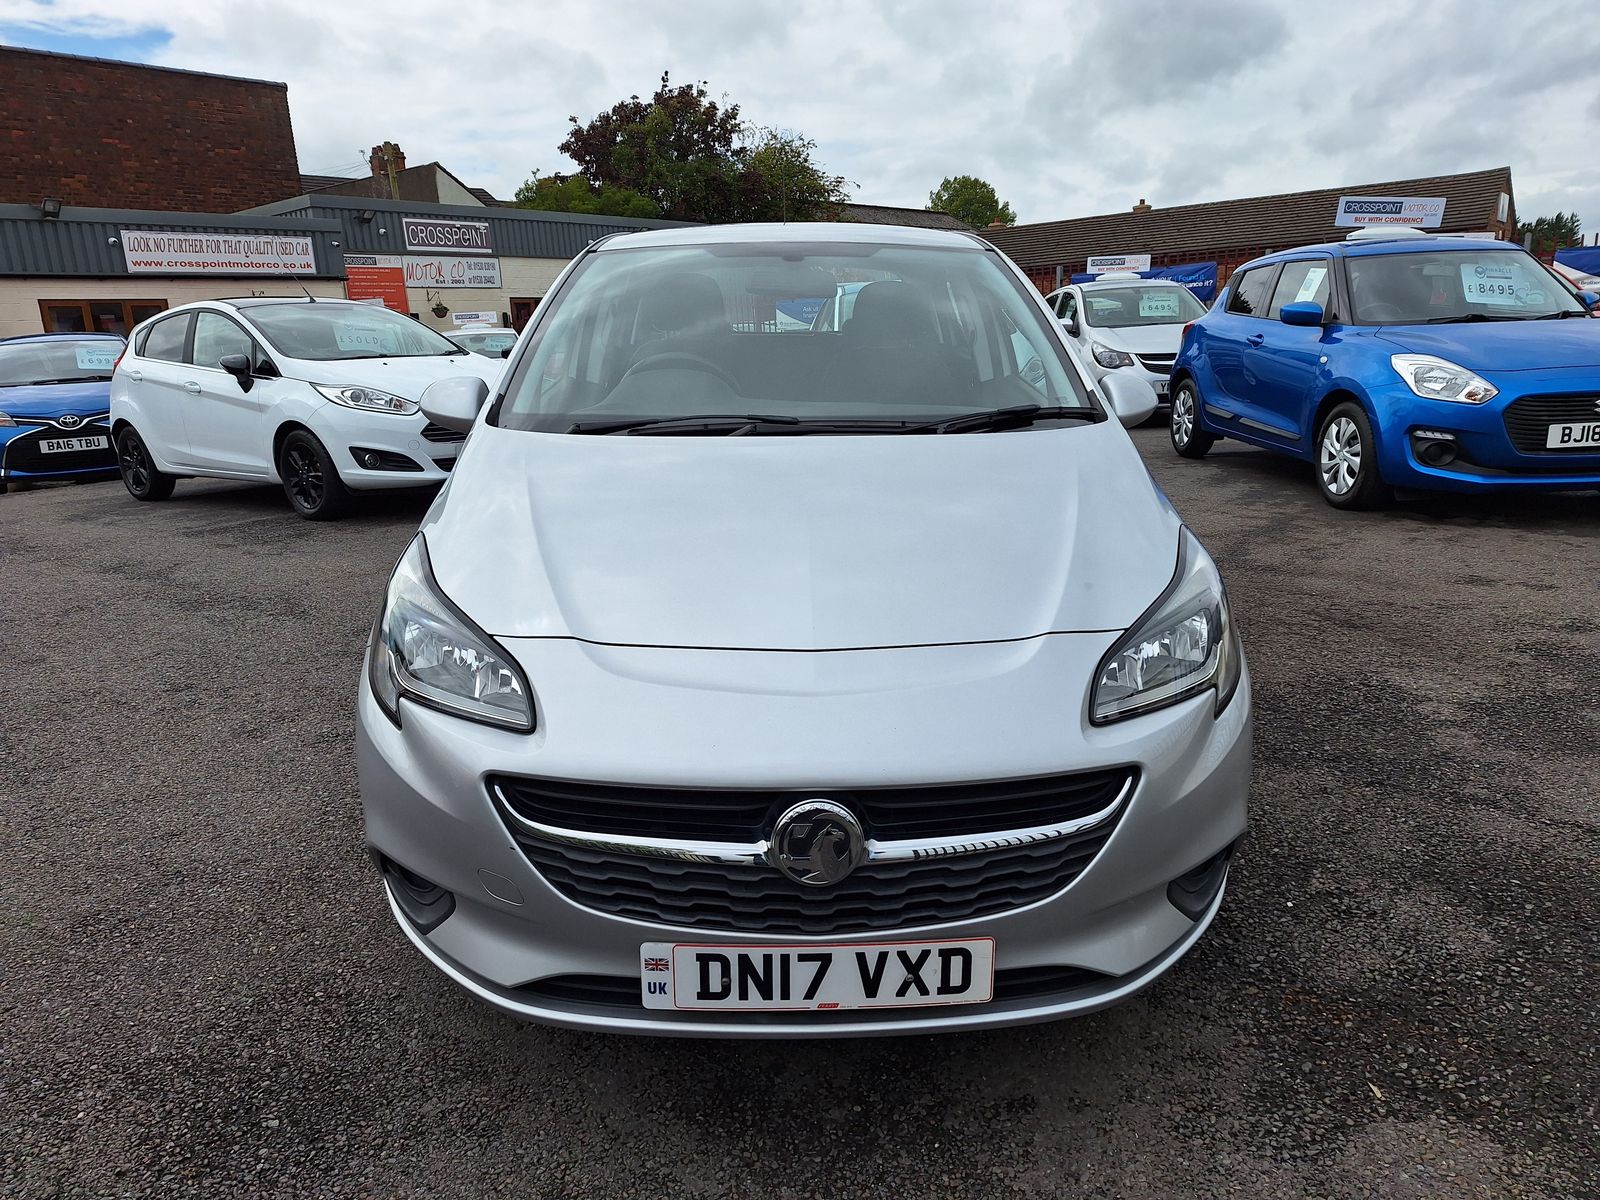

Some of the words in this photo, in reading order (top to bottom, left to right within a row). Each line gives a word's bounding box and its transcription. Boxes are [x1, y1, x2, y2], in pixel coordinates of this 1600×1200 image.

[1345, 202, 1402, 213] CROSSPOINT
[408, 225, 488, 247] CROSSPOINT
[127, 236, 153, 252] LOOK
[152, 237, 166, 253] NO
[167, 238, 205, 254] FURTHER
[205, 239, 222, 254] FOR
[222, 239, 242, 255] THAT
[242, 240, 275, 258] QUALITY
[275, 241, 294, 256] USED
[295, 241, 310, 256] CAR
[343, 257, 377, 265] CROSSPOINT
[1090, 258, 1126, 266] CROSSPOINT
[406, 260, 445, 283] MOTOR
[450, 260, 466, 279] CO
[1478, 283, 1515, 296] 8495
[347, 335, 379, 345] SOLD
[88, 357, 115, 365] 699
[46, 439, 75, 451] BA16
[76, 437, 101, 449] TBU
[695, 952, 833, 1001] DN17
[854, 946, 974, 998] VXD
[647, 981, 668, 995] UK
